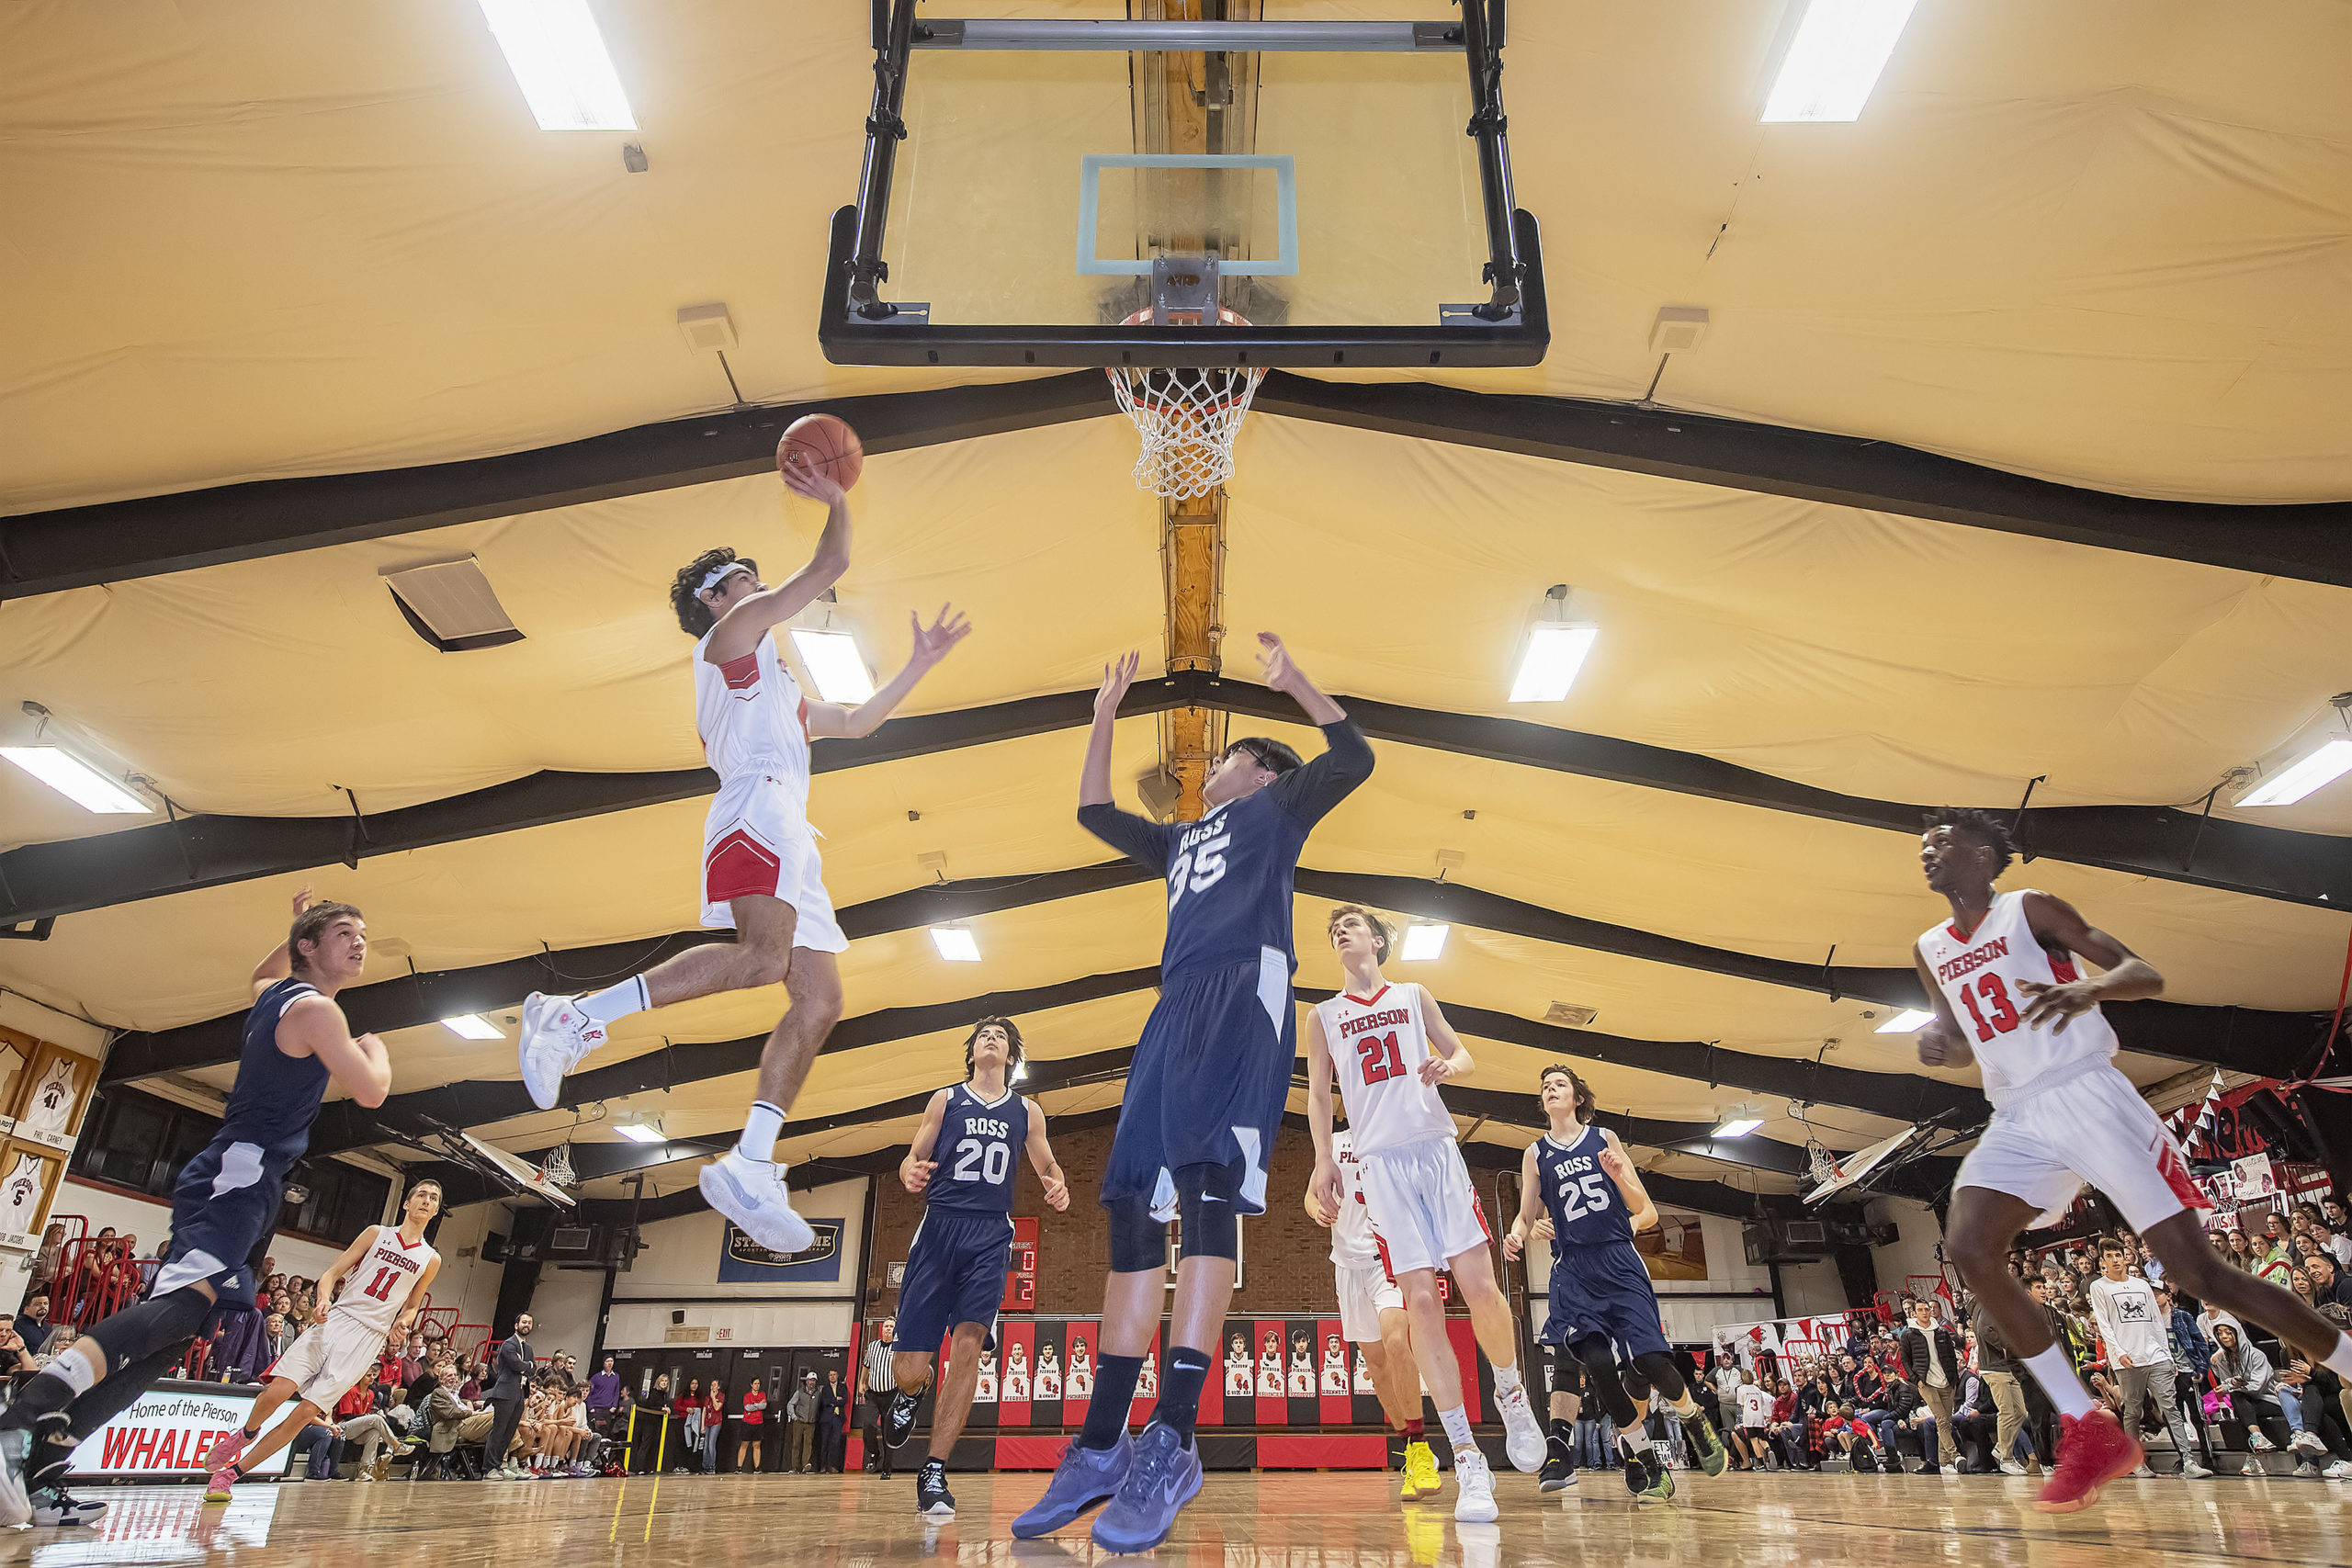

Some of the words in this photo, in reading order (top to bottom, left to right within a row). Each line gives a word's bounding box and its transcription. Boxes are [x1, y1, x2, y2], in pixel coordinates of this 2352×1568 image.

[1178, 812, 1228, 856] ROSS
[1169, 832, 1231, 913] 35
[1939, 937, 2010, 986] PIERSON
[1960, 972, 2020, 1043] 13
[1340, 1009, 1409, 1039] PIERSON
[1356, 1031, 1408, 1086] 21
[44, 1093, 59, 1110] 41
[965, 1117, 1009, 1139] ROSS
[953, 1138, 1010, 1185] 20
[1554, 1156, 1592, 1179] ROSS
[13, 1190, 25, 1206] 5
[1558, 1172, 1610, 1222] 25
[374, 1247, 420, 1275] PIERSON
[364, 1267, 401, 1302] 11
[1021, 1280, 1033, 1301] 2
[718, 1328, 731, 1338] EXIT
[130, 1402, 165, 1419] Home
[168, 1399, 183, 1416] of
[183, 1400, 200, 1417] the
[201, 1402, 238, 1424] Pierson
[1749, 1399, 1758, 1412] 3
